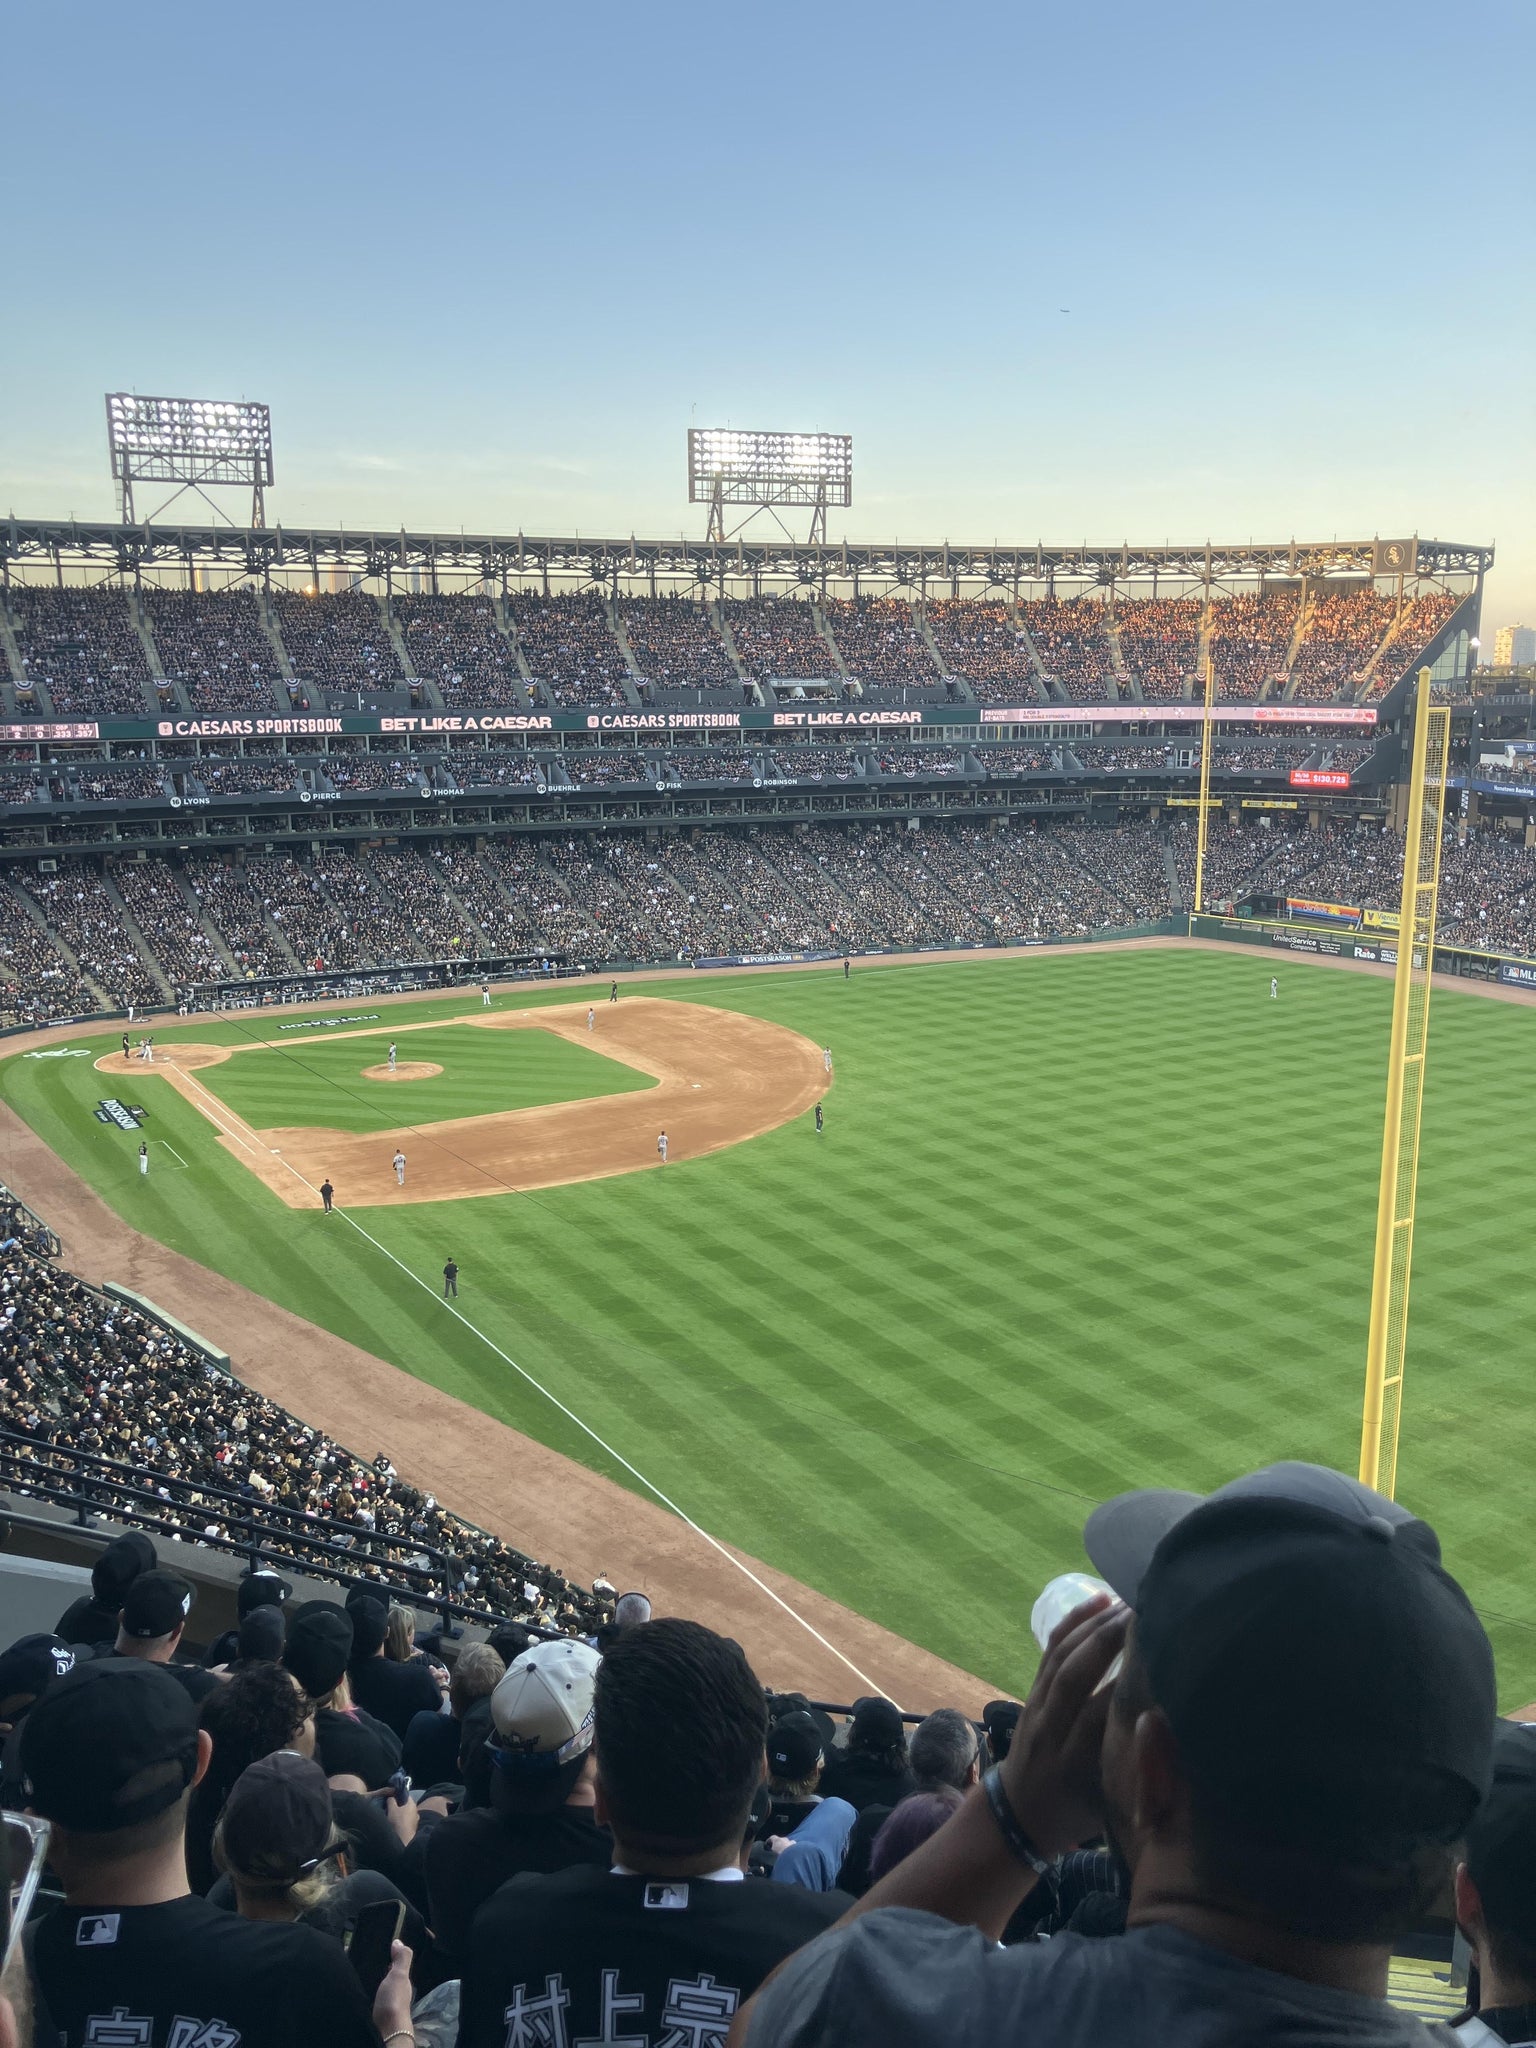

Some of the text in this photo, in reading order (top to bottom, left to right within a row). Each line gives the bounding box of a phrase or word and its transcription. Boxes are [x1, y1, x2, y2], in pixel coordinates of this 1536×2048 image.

[380, 716, 552, 731] BET LIKE A CAESAR
[601, 713, 741, 728] CAESARS SPORTSBOOK
[773, 711, 923, 726] BET LIKE A CAESAR
[175, 718, 343, 736] CAESARS SPORTSBOOK
[312, 792, 341, 800] PIERCE
[433, 788, 465, 796] THOMAS
[1493, 785, 1534, 796] Hometown Banking
[183, 797, 210, 805] LYONS
[1377, 913, 1399, 923] Vienna
[750, 954, 792, 963] POSTSEASON
[1354, 947, 1376, 960] Rate
[100, 1099, 140, 1130] POSTSEASON
[387, 1527, 398, 1535] 23
